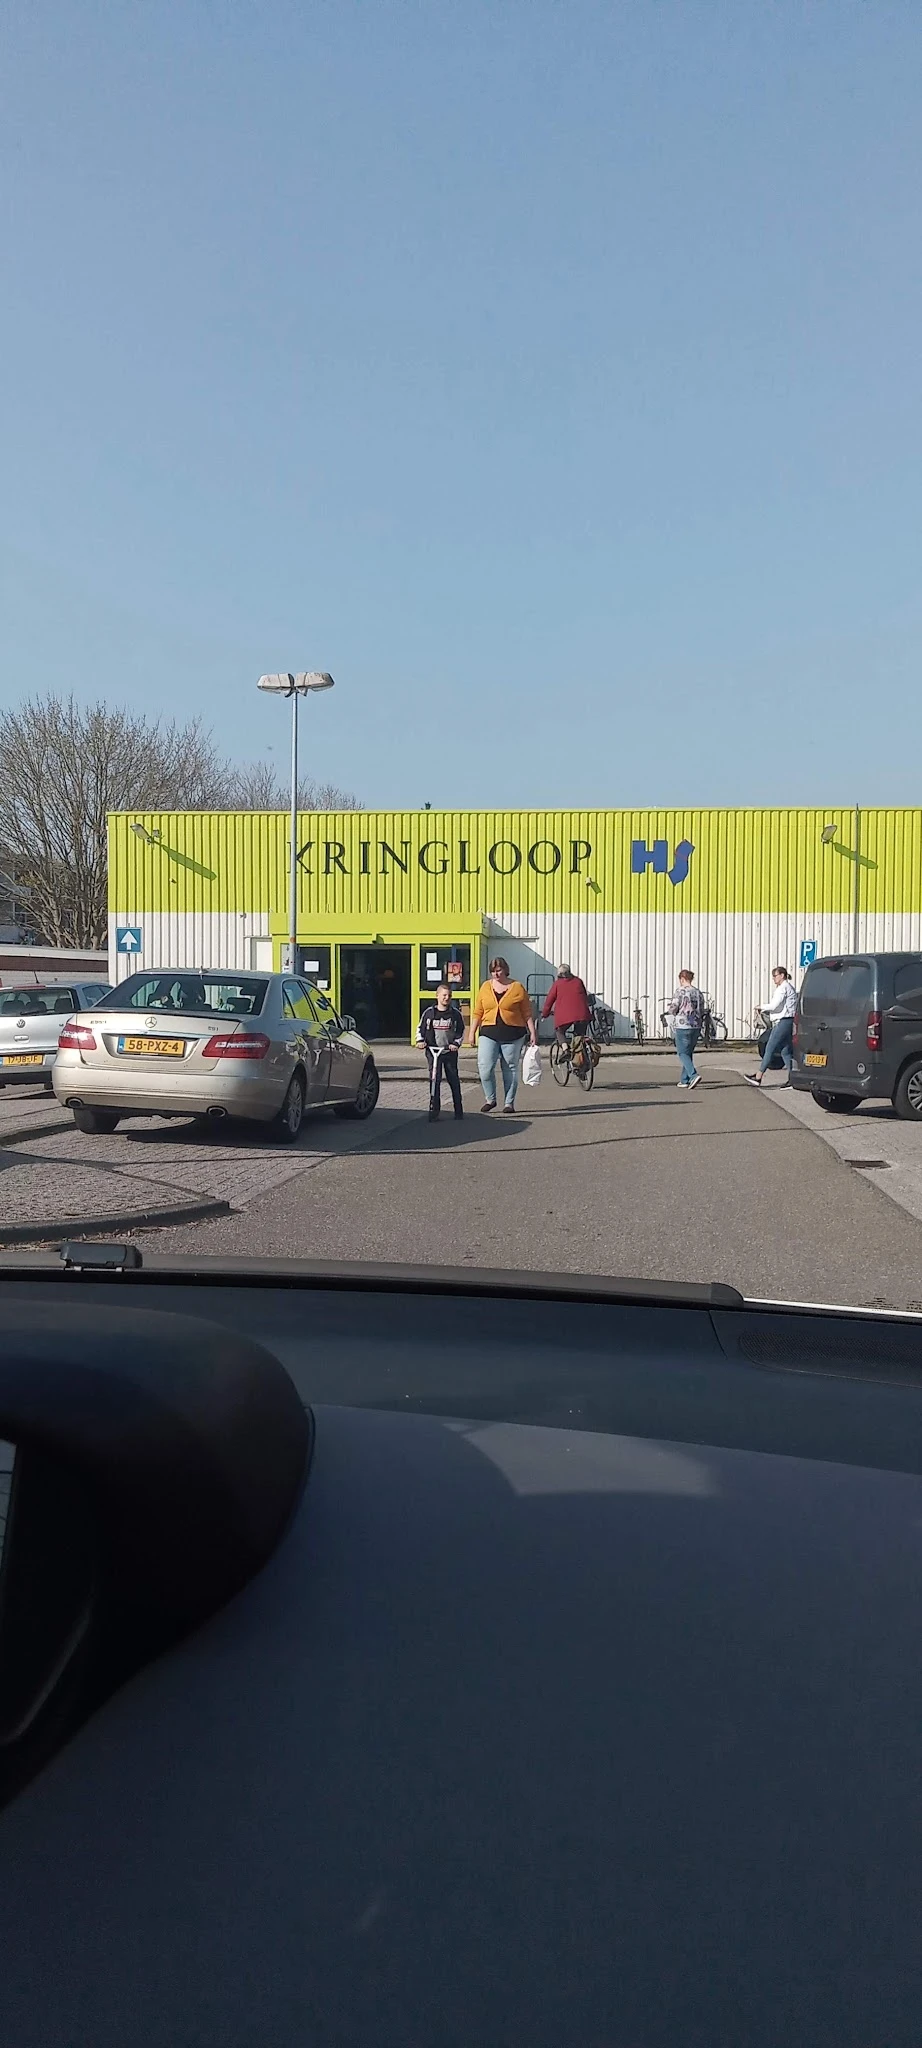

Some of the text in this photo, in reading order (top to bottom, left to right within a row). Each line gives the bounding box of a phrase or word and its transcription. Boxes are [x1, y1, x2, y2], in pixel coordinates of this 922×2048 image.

[286, 840, 592, 875] KRINGLOOP
[803, 942, 813, 957] P
[128, 1039, 179, 1052] 58-PXZ-4
